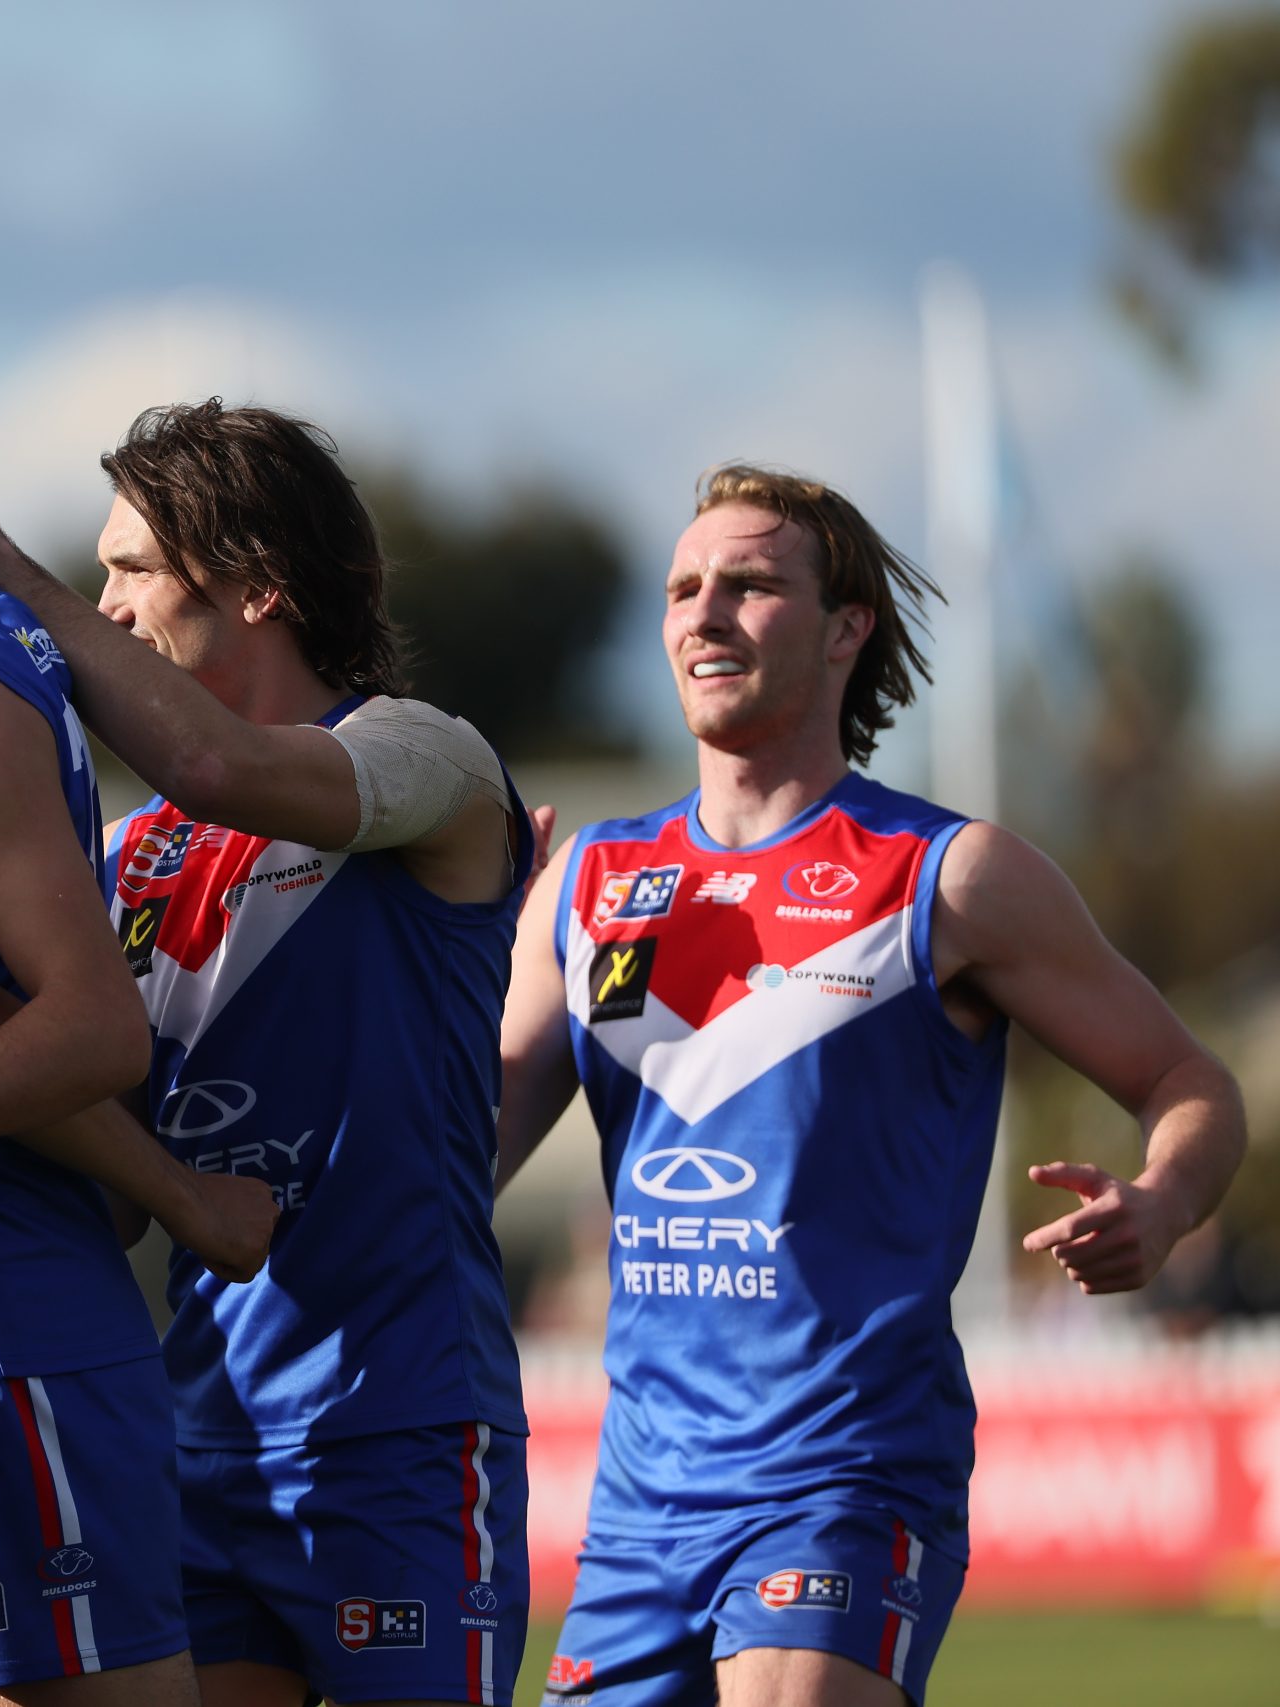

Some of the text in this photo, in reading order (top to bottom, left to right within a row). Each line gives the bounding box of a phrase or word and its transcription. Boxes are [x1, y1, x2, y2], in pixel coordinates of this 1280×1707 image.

[247, 859, 322, 886] OPYWORLD
[274, 873, 325, 894] TOSHIBA
[775, 905, 854, 921] BULLDOGS
[786, 970, 875, 986] COPYWORLD
[821, 984, 873, 999] TOSHIBA
[186, 1130, 315, 1176] ERY
[613, 1214, 796, 1253] CHERY
[621, 1260, 778, 1300] PETER PAGE
[41, 1580, 97, 1597] BULLDOGS
[460, 1617, 498, 1628] BULLDOGS
[381, 1632, 418, 1640] HOSTPLUS
[547, 1655, 594, 1686] EM
